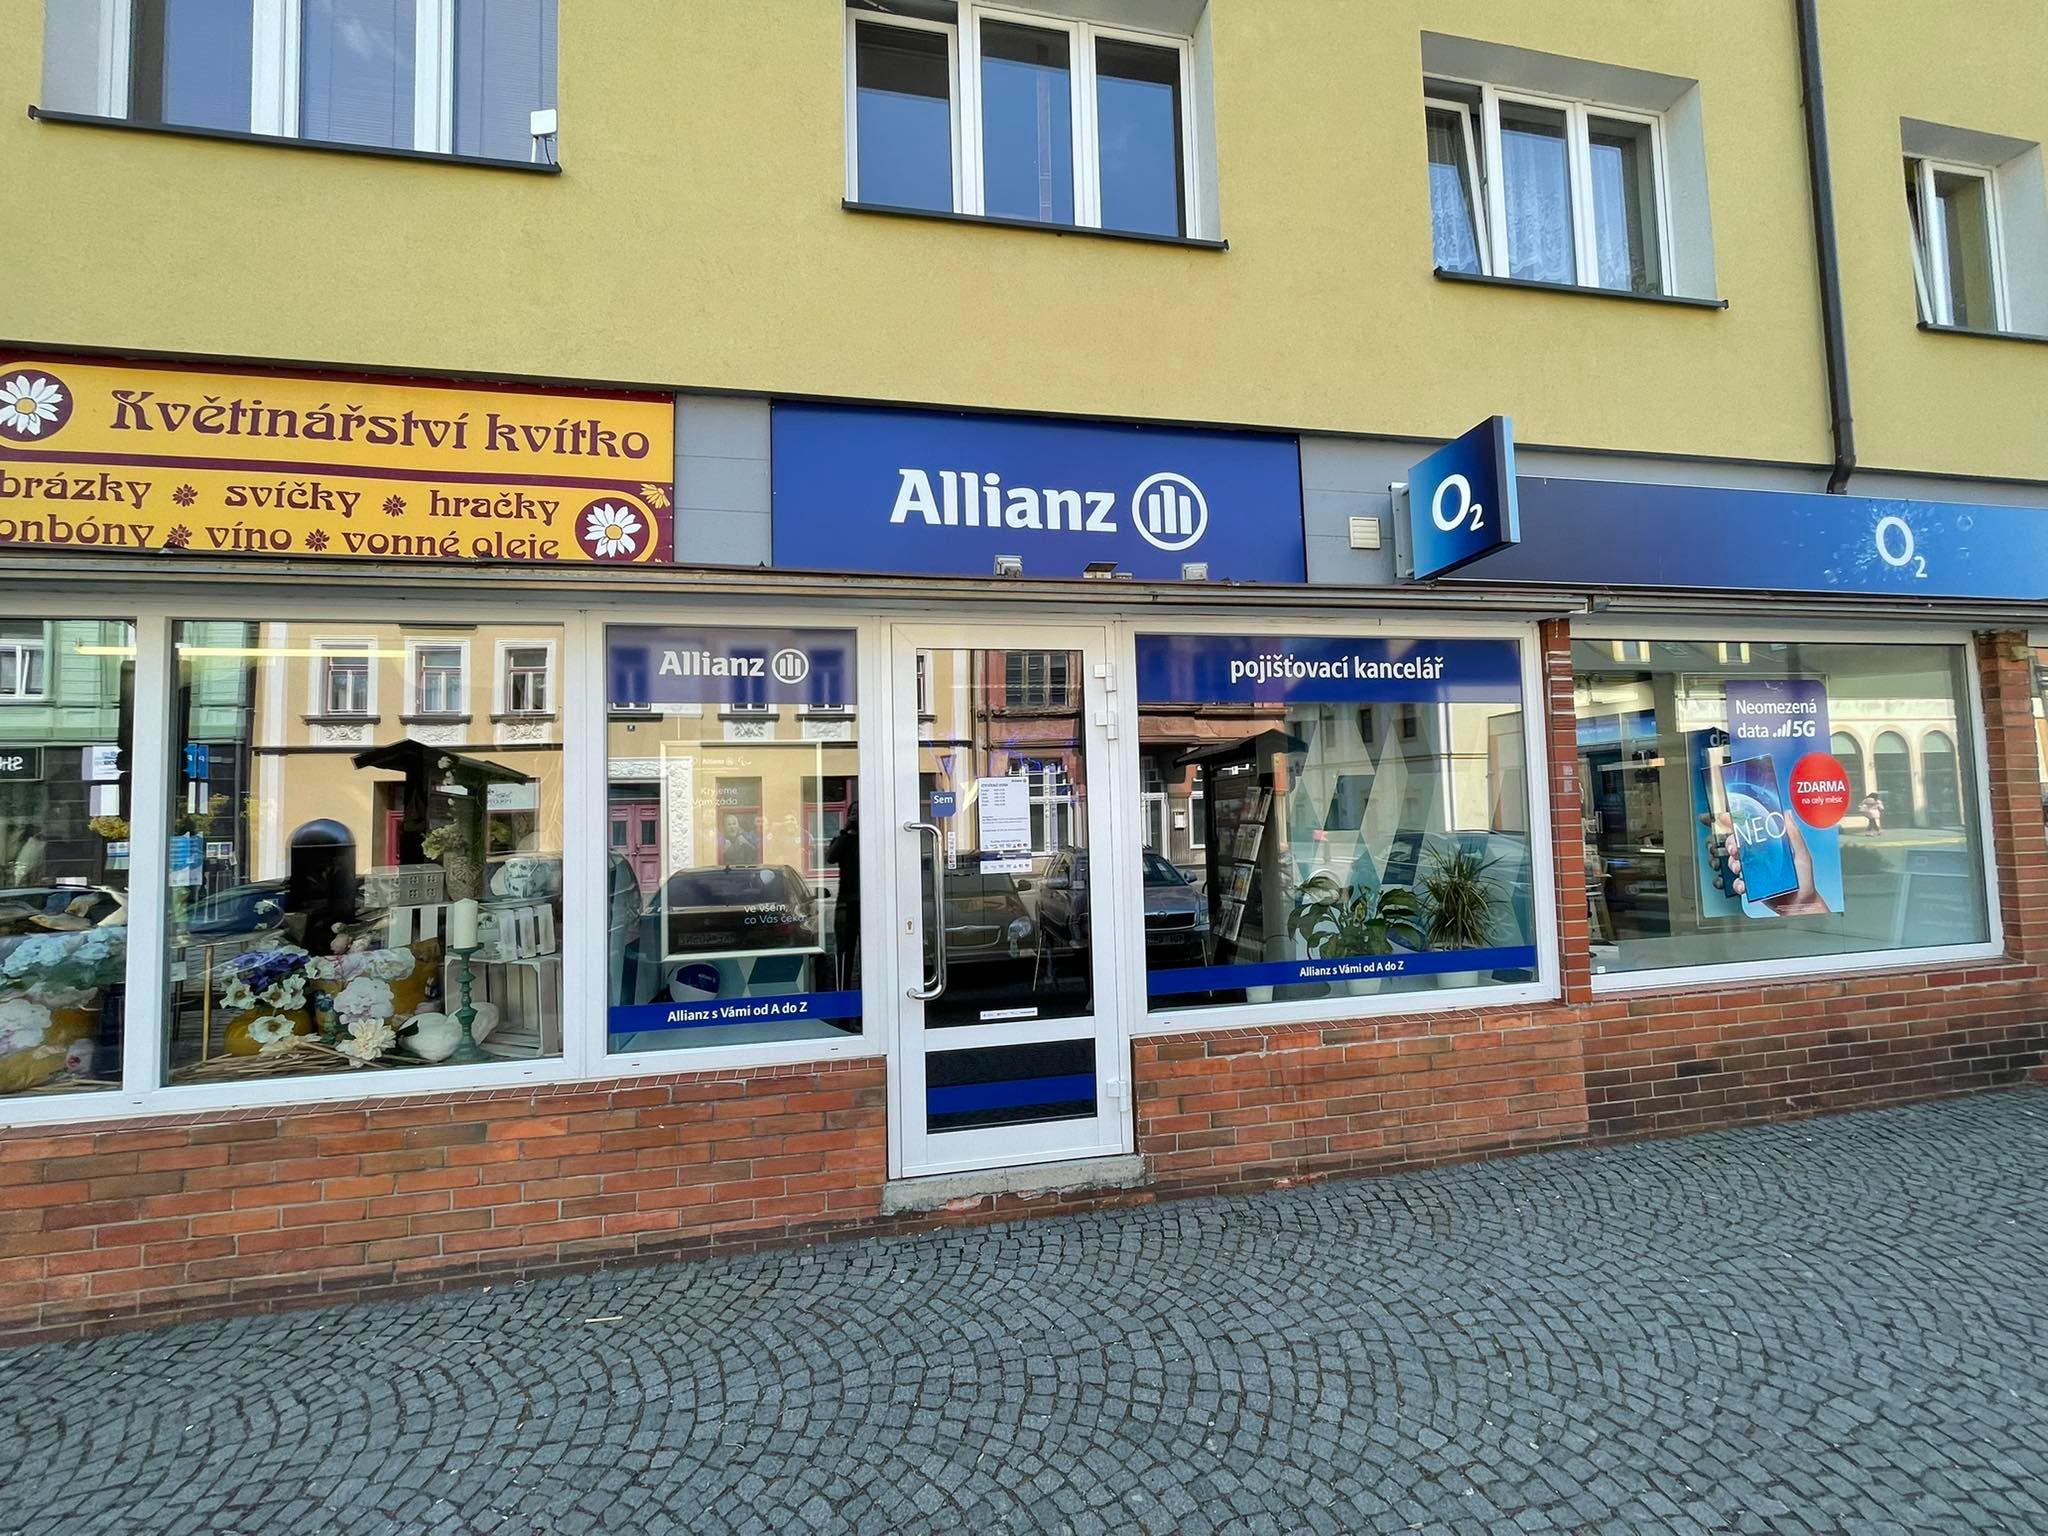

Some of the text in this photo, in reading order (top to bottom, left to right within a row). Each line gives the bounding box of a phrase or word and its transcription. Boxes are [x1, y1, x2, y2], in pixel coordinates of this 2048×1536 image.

[110, 389, 649, 459] Květinářství kvítko
[224, 481, 361, 518] svíčky
[429, 489, 560, 526] hračky
[889, 467, 1118, 533] Allianz
[1432, 473, 1485, 532] O2
[205, 521, 292, 550] víno
[341, 530, 460, 557] vonné
[471, 531, 560, 560] oleje
[1875, 516, 1928, 578] O2
[658, 651, 765, 677] Allianz
[1230, 653, 1444, 684] pojišťovací kancelář
[1735, 698, 1817, 715] Neomezená
[1737, 720, 1816, 738] data 5G
[933, 795, 954, 803] Sem
[1796, 780, 1846, 794] ZDARMA
[1734, 811, 1787, 849] NEO
[744, 904, 756, 913] ve
[744, 915, 757, 925] co
[1299, 960, 1404, 977] Allianz s Vámi od A do Z
[667, 1001, 808, 1022] Allianz s Vámi od A do Z
